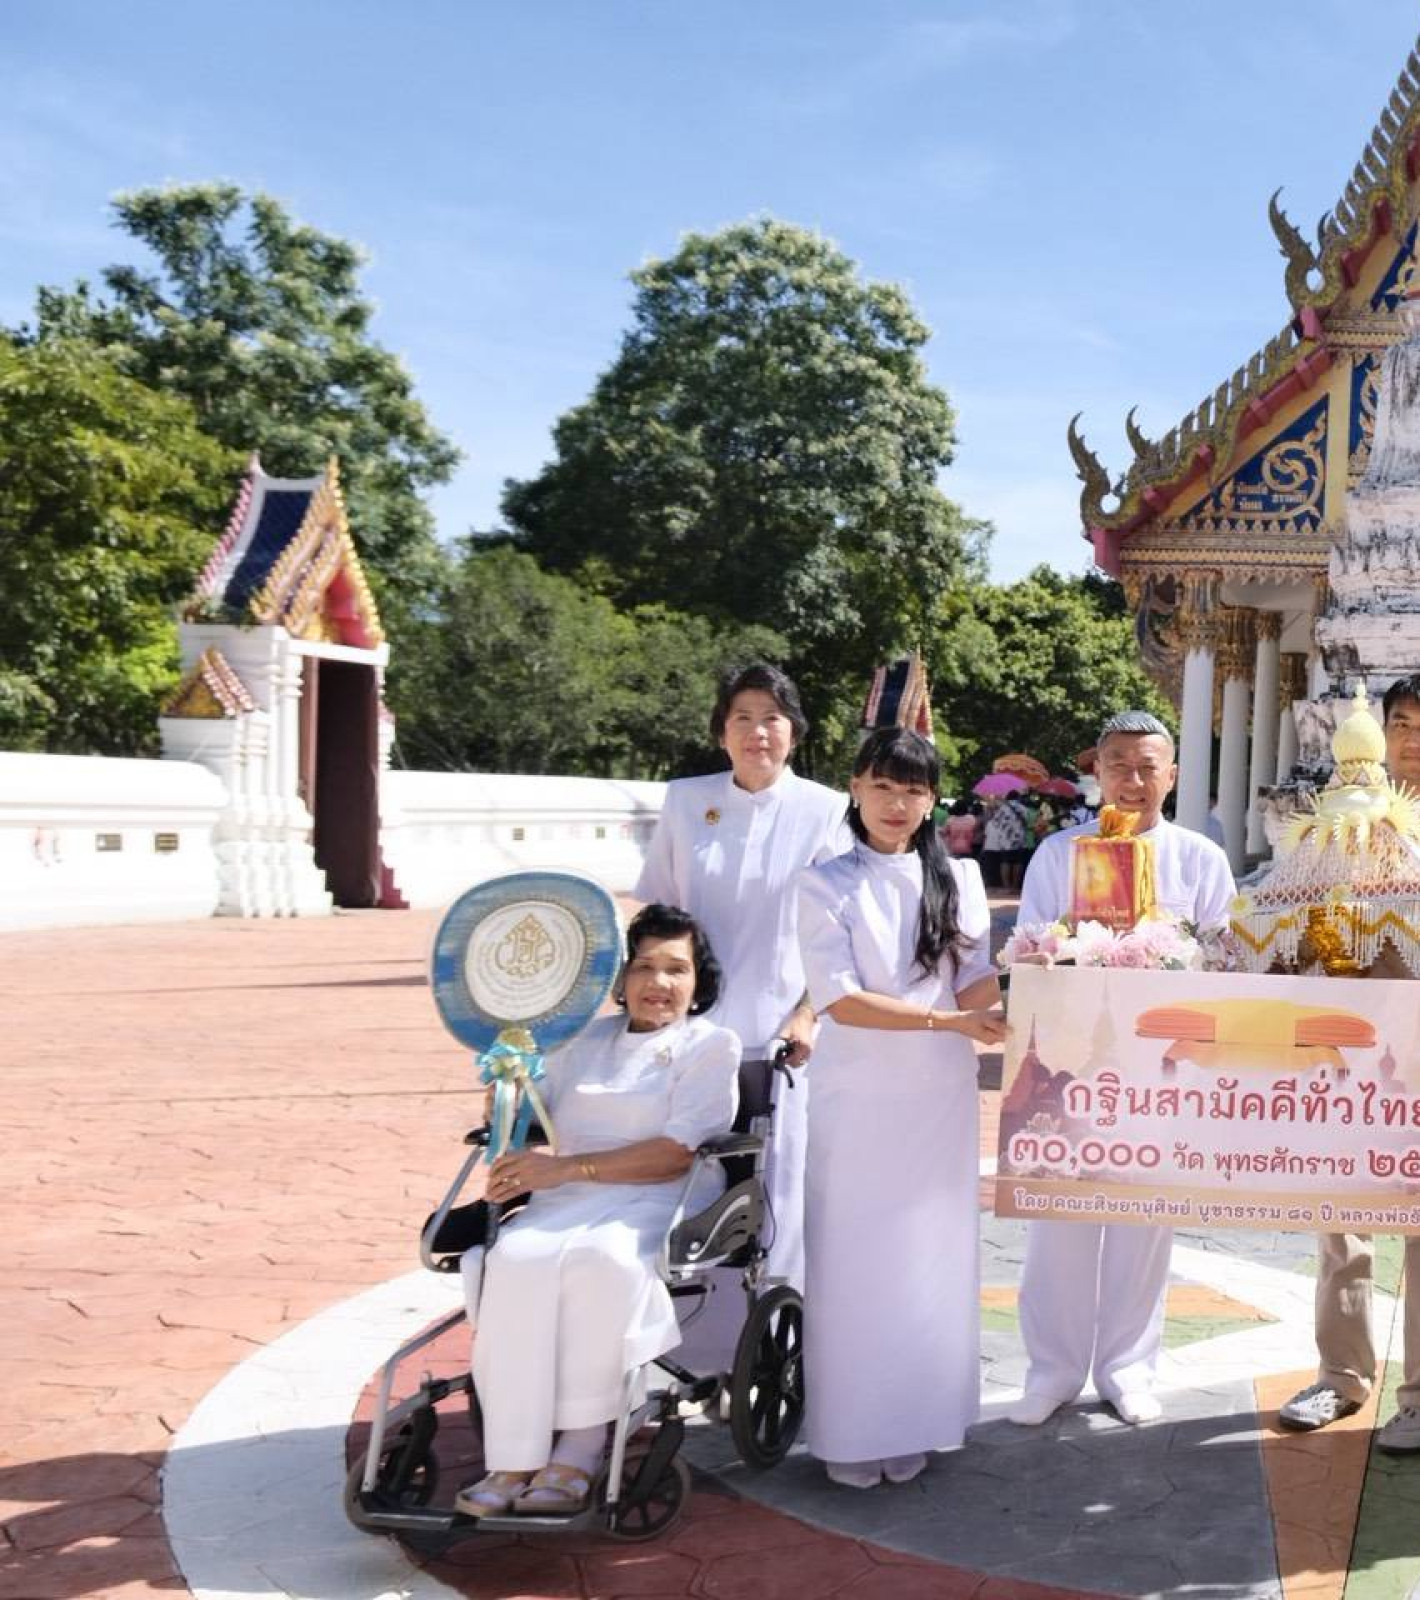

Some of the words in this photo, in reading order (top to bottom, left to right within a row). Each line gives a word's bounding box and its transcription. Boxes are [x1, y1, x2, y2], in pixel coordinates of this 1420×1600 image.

[1013, 1139, 1162, 1170] ๓๐,๐๐๐
[1172, 1141, 1205, 1171] วัด
[1213, 1146, 1356, 1181] พุทธศักราช
[1014, 1189, 1048, 1209] โดย
[1053, 1195, 1191, 1217] คณะศิษยานุศิษย์
[1199, 1204, 1281, 1223] บูชาธรรม
[1321, 1204, 1334, 1222] ปี
